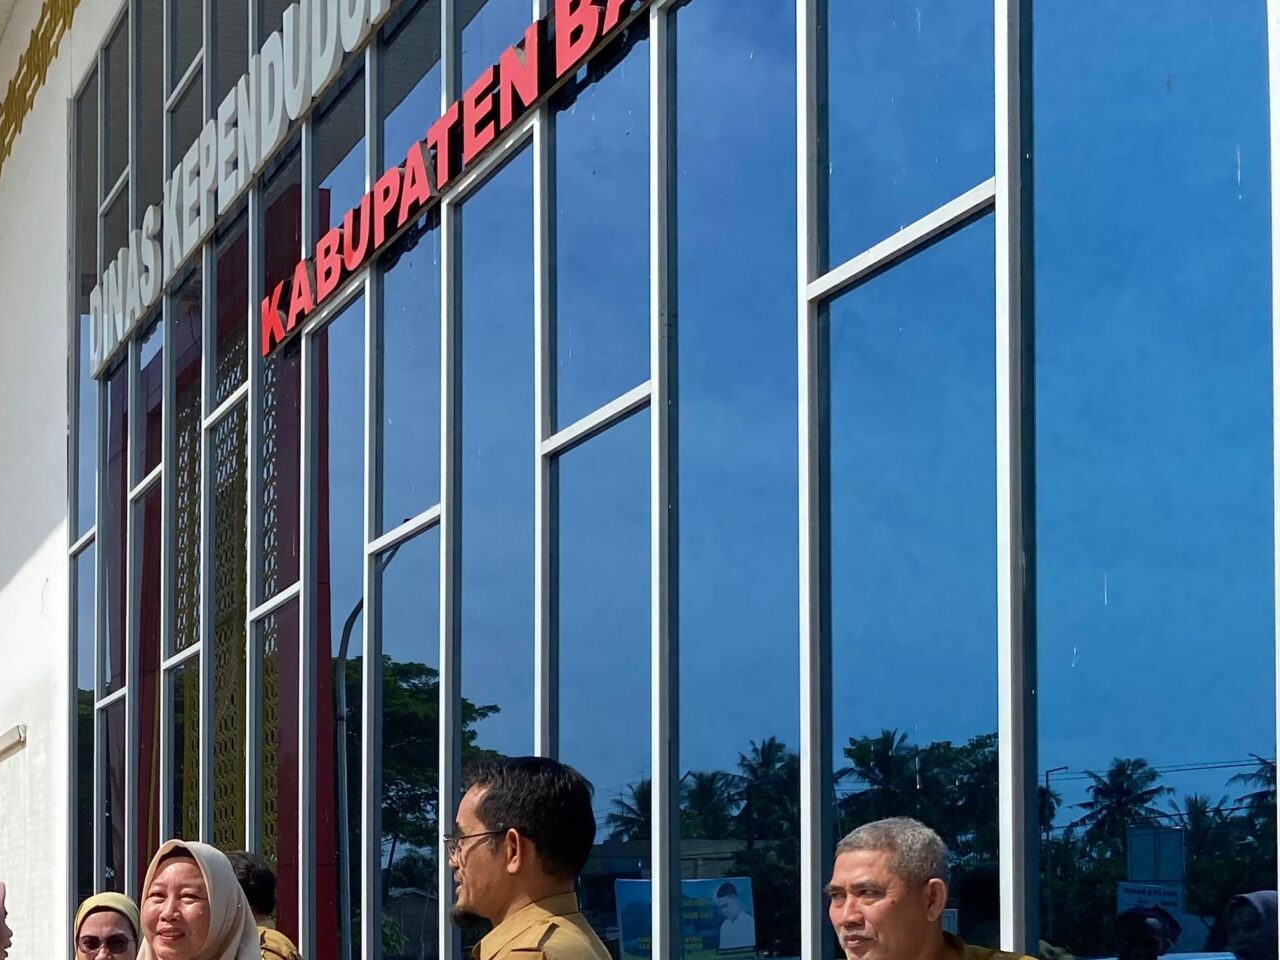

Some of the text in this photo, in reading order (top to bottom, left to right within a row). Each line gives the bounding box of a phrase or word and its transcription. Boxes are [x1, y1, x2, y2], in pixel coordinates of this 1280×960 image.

[90, 0, 392, 379] DINAS KEPENDUD
[261, 20, 539, 357] KABUPATEN
